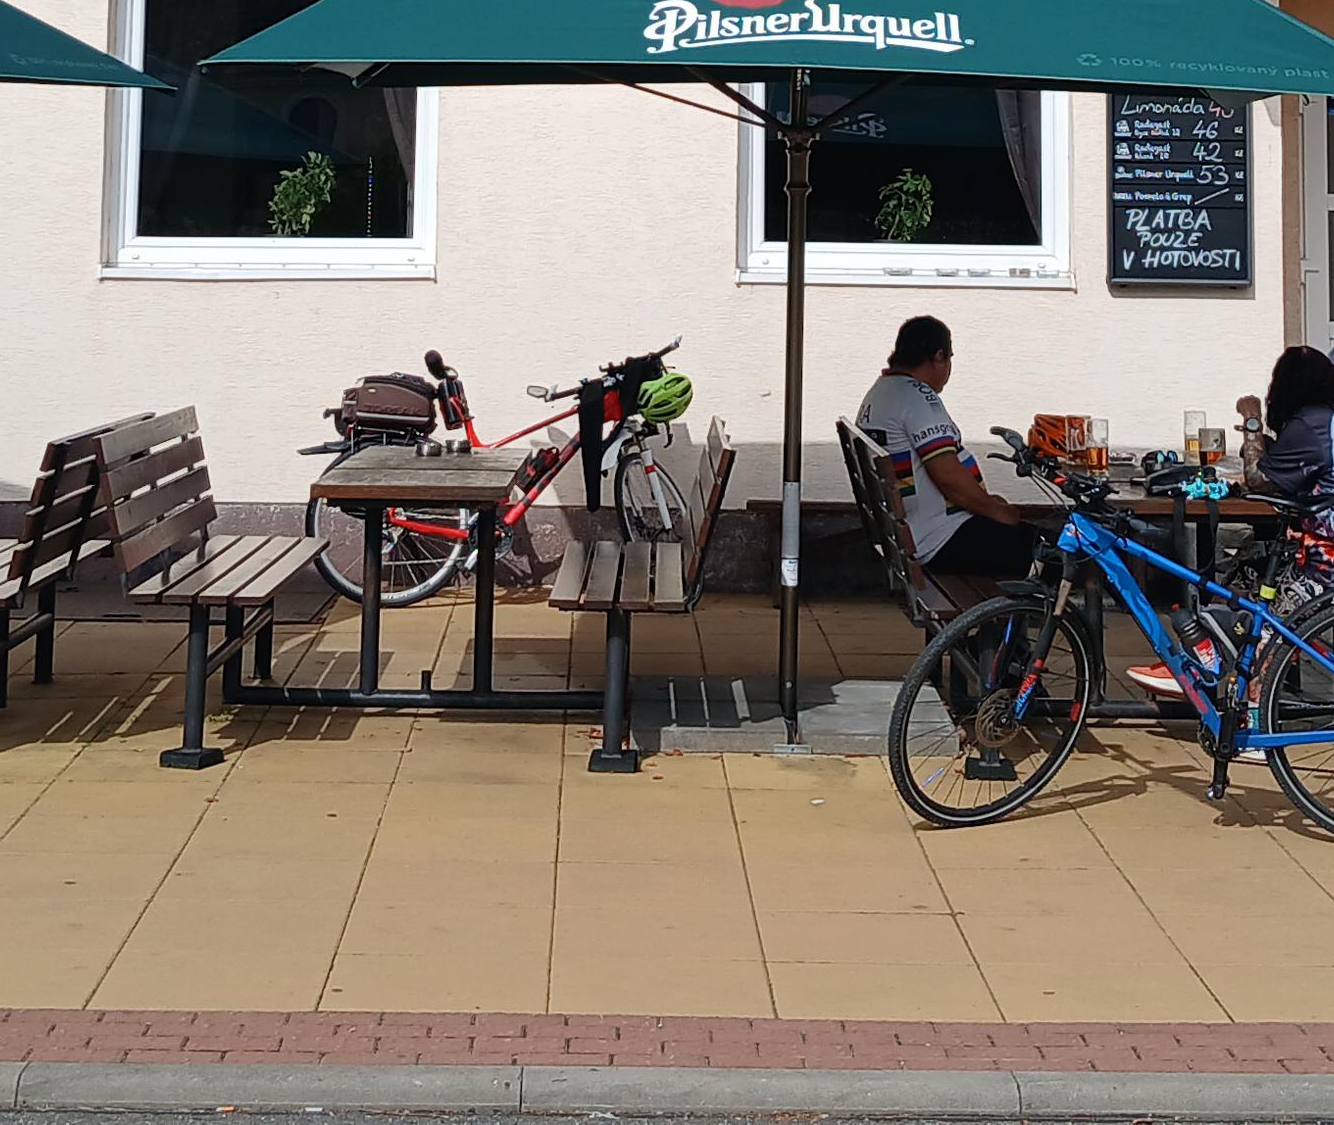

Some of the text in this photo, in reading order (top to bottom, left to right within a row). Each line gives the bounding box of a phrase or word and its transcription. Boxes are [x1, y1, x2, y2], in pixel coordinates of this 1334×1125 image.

[1110, 57, 1161, 69] 100%
[1120, 94, 1206, 116] Limonáda
[1192, 119, 1219, 139] 46
[1192, 141, 1223, 162] 42
[1196, 164, 1230, 185] 53
[1125, 208, 1212, 231] PLATBA
[1136, 230, 1204, 248] POUZE
[1123, 248, 1241, 272] V HOTOVOSTI
